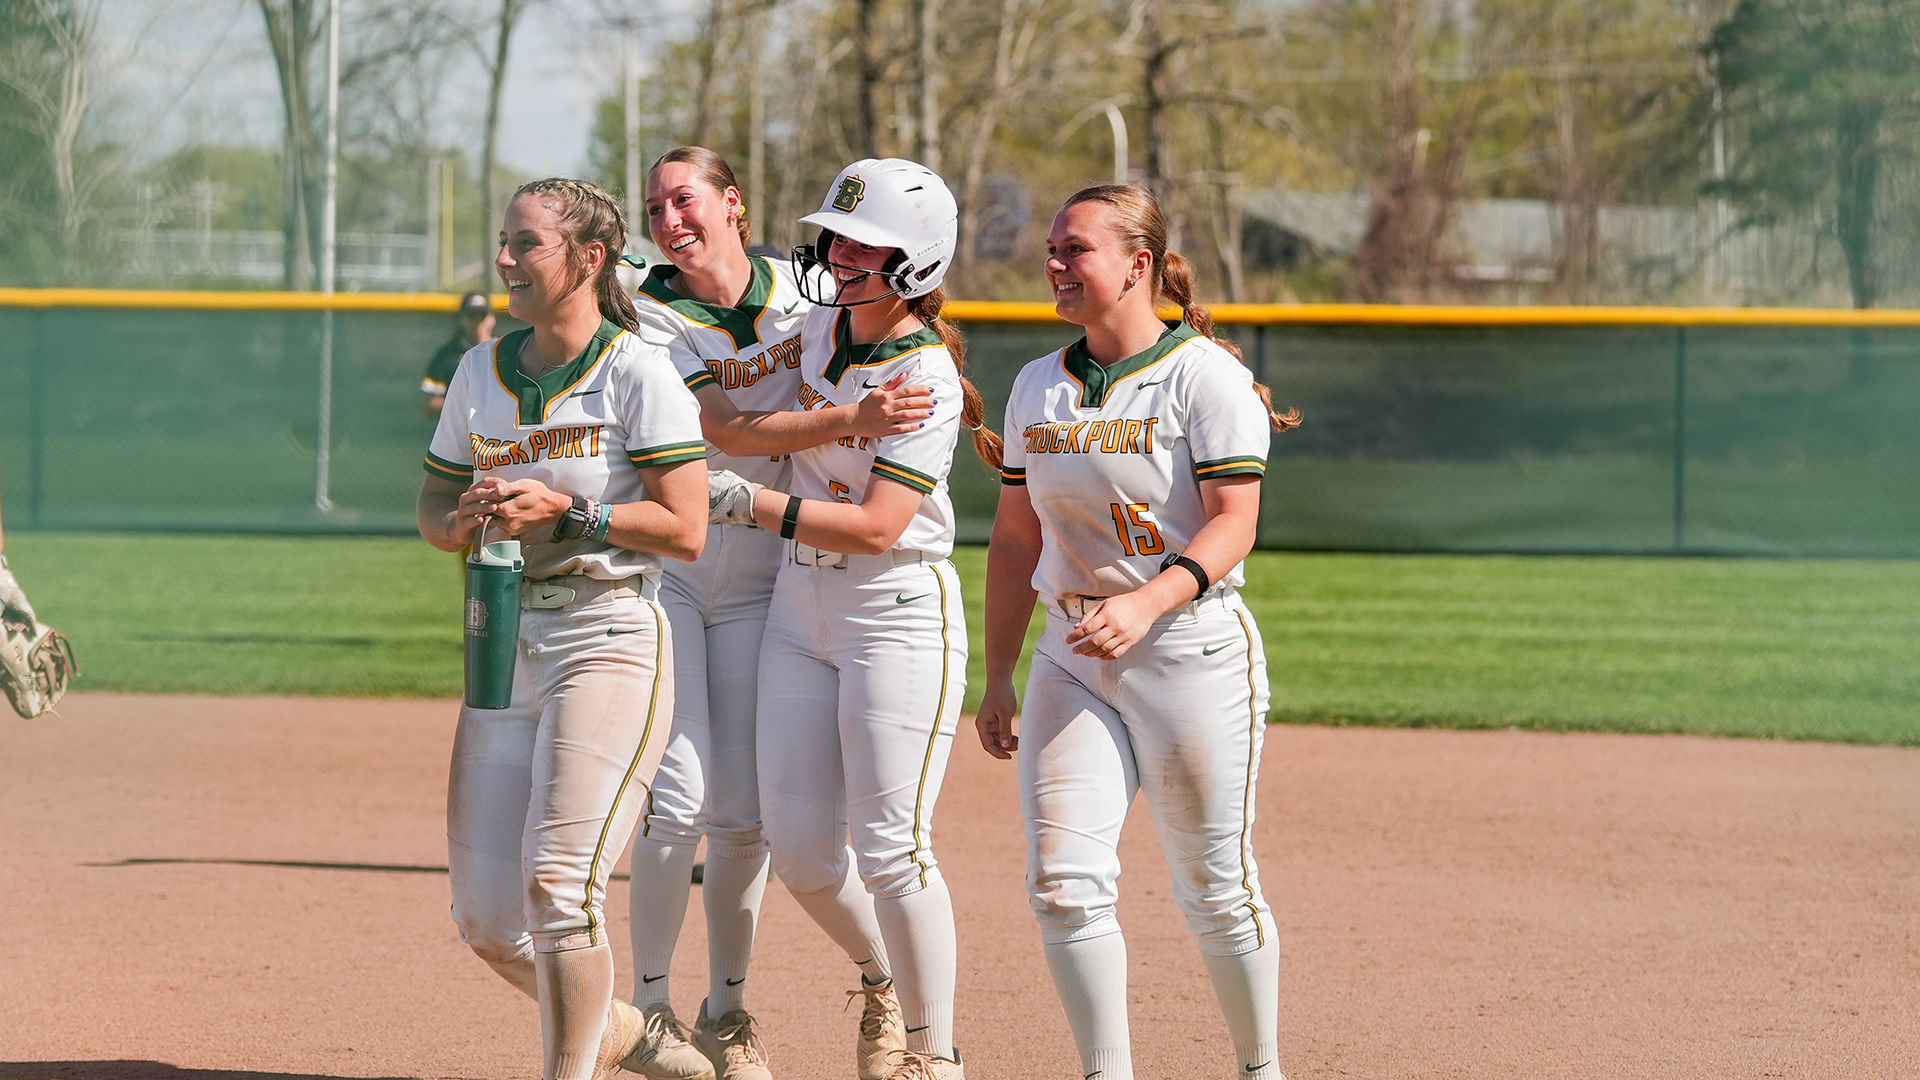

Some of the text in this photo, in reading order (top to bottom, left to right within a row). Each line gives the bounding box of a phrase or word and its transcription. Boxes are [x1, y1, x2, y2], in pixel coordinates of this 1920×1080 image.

[832, 175, 866, 213] B
[706, 334, 801, 390] ROCKPO
[1110, 502, 1166, 557] 15
[464, 628, 489, 638] OFTBALL
